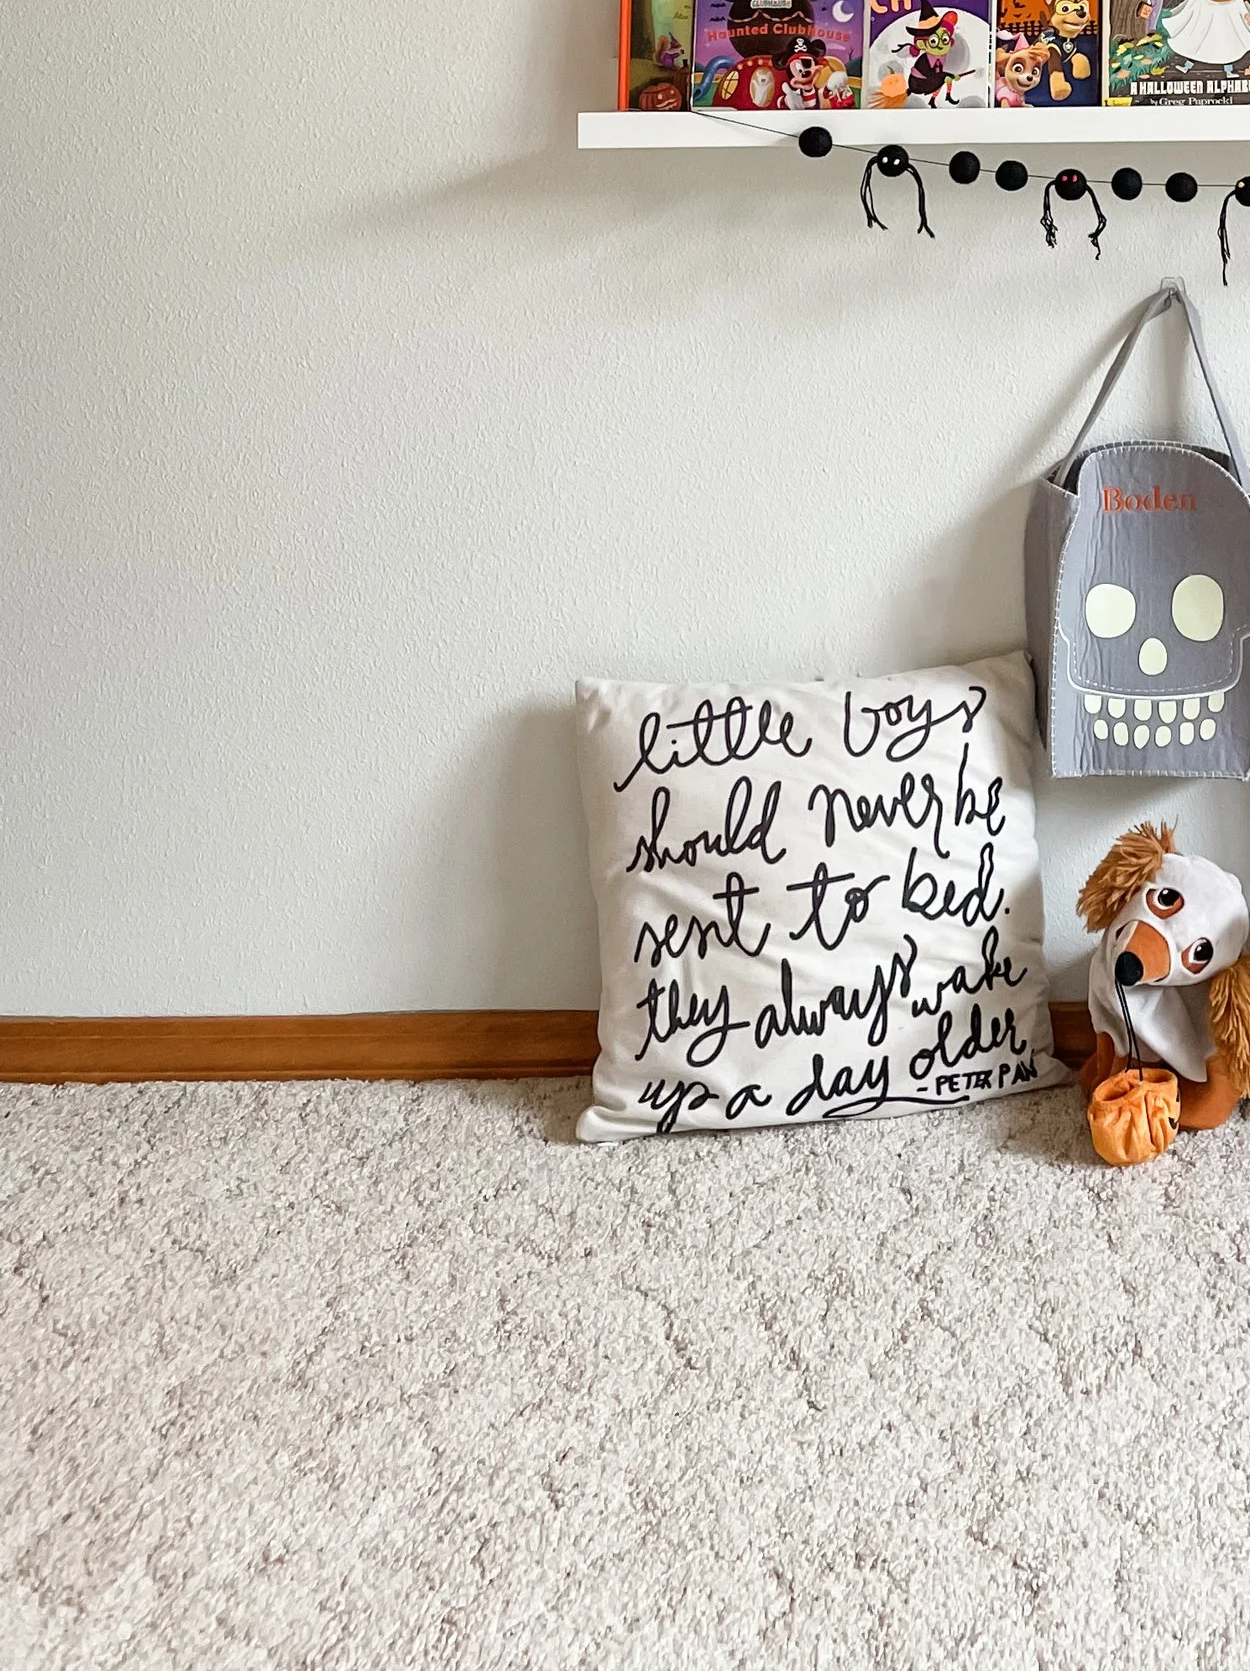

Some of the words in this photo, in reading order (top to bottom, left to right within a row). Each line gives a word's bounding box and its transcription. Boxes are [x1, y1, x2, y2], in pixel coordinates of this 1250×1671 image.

[707, 24, 768, 42] Haunted
[1130, 82, 1138, 95] A
[1139, 81, 1204, 95] HALLOWEEN
[1158, 97, 1186, 106] Greg
[1102, 485, 1197, 512] Boden
[613, 695, 813, 792] little
[842, 686, 987, 762] boys
[626, 776, 788, 874] should
[808, 772, 950, 859] never
[954, 742, 1007, 836] be
[634, 871, 771, 967] sent
[786, 862, 891, 950] to
[635, 980, 751, 1068] they
[754, 934, 918, 1048] always
[911, 926, 1028, 1018] wake
[637, 1078, 720, 1134] up
[724, 1084, 771, 1120] a
[908, 1003, 1028, 1081] older
[936, 1069, 993, 1096] PETER
[999, 1057, 1038, 1089] PAN
